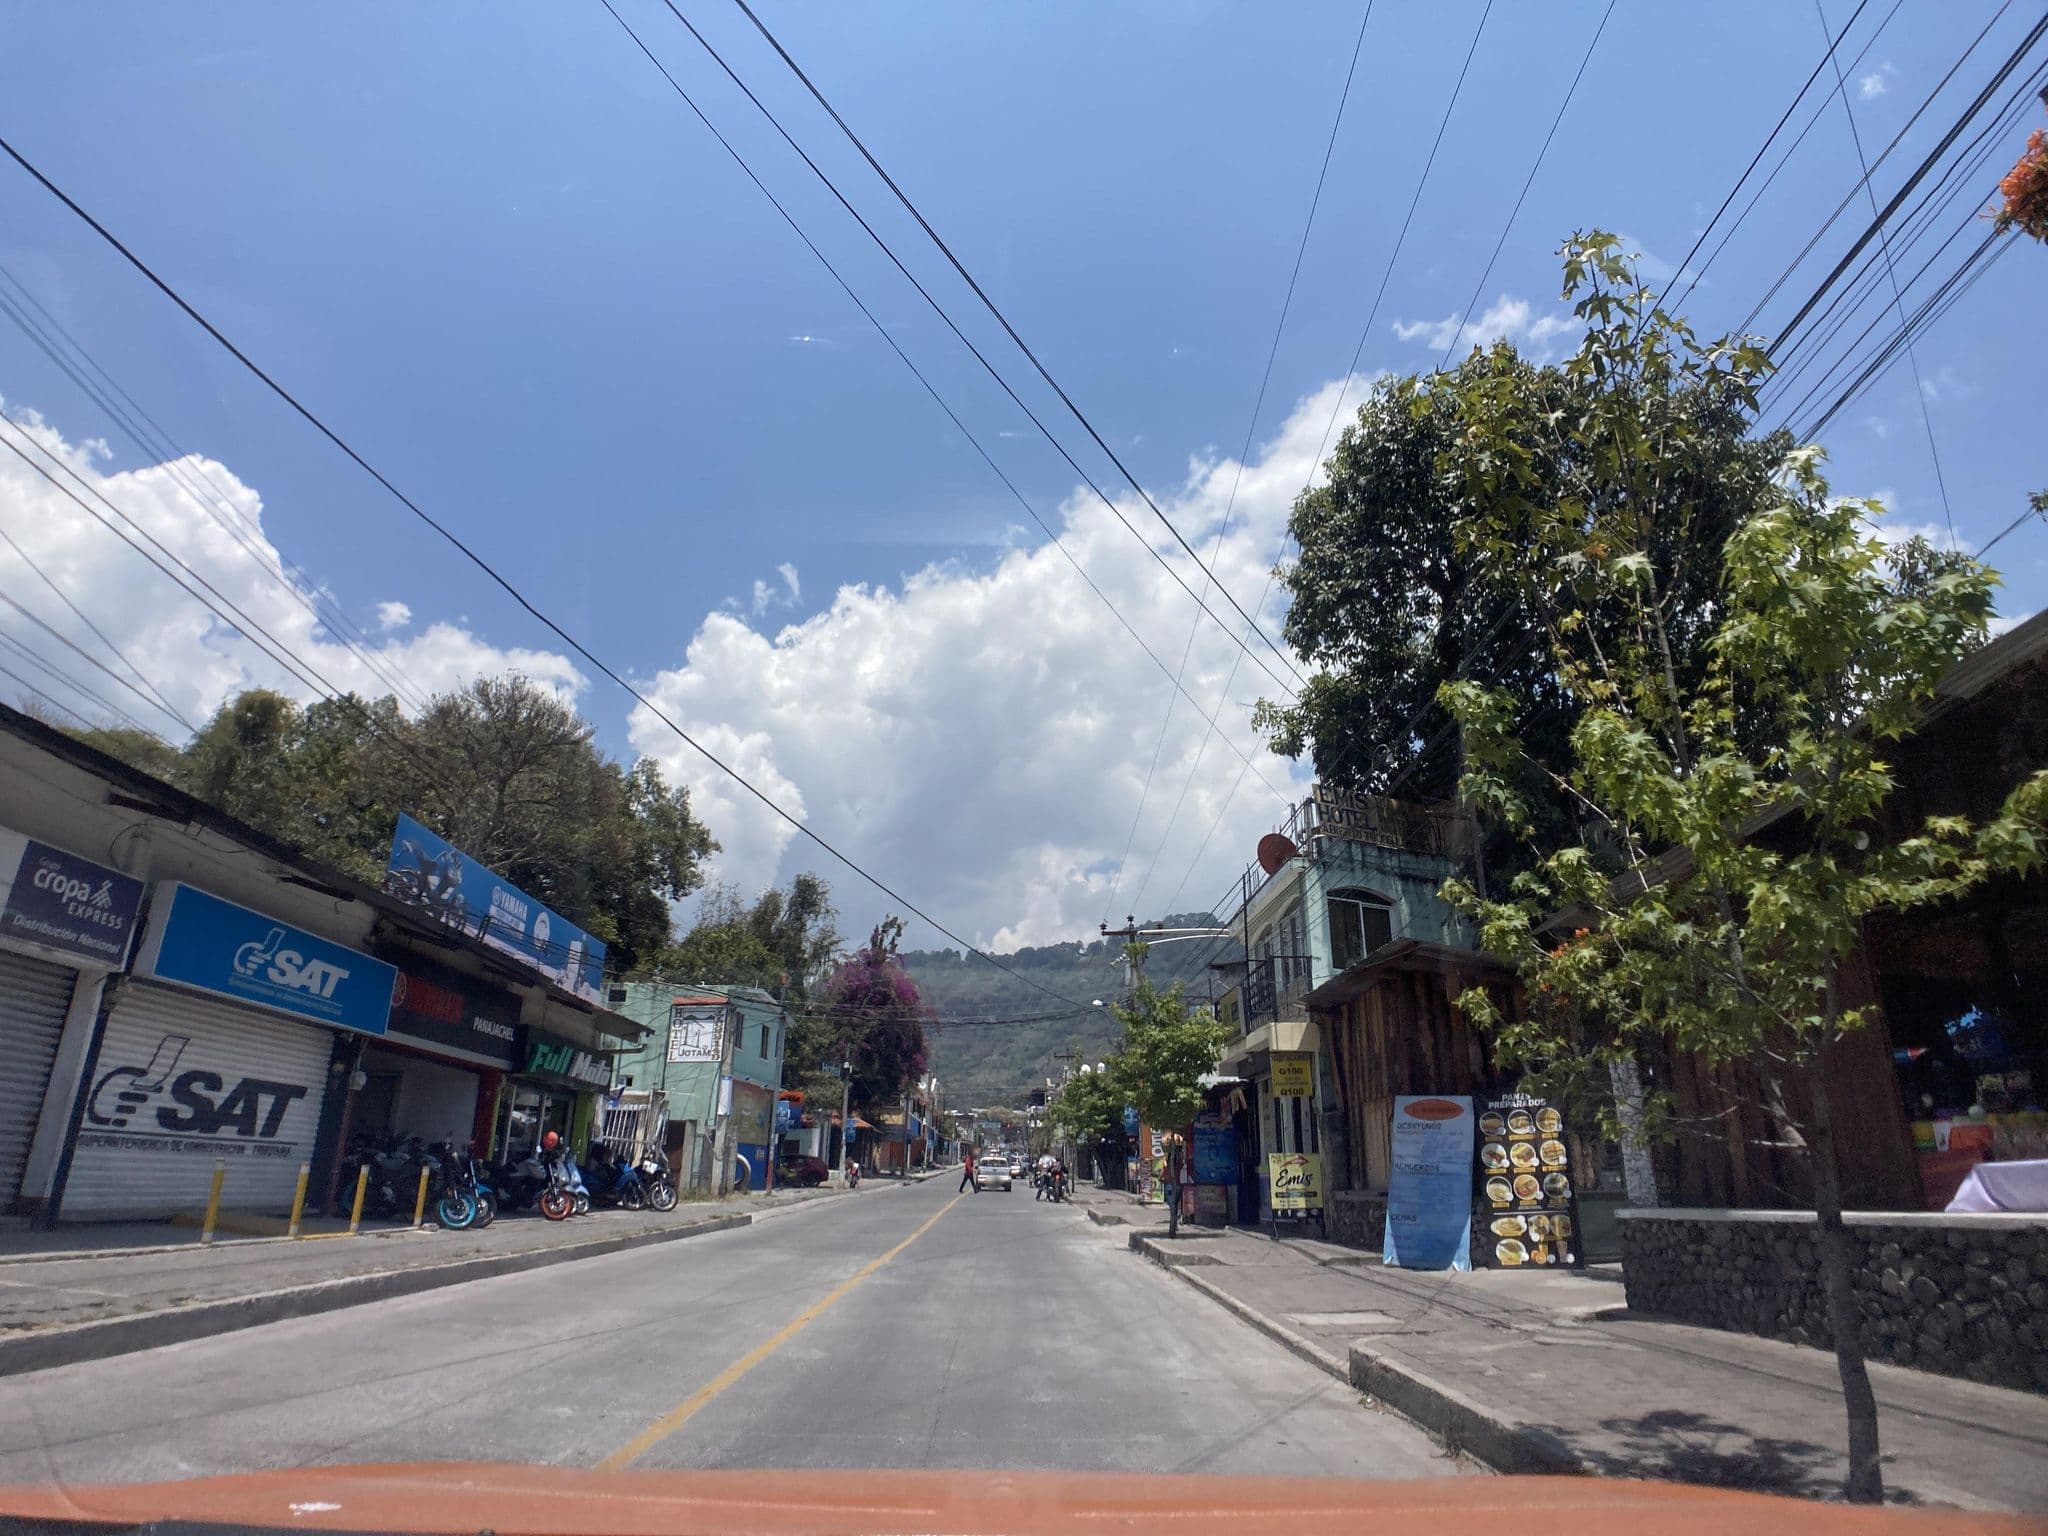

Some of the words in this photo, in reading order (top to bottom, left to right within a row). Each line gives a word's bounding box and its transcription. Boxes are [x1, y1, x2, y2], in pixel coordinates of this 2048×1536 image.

[33, 868, 91, 903] cropa
[67, 902, 123, 930] EXPRESS
[500, 890, 528, 922] YAMAHA
[267, 949, 351, 998] SAT
[473, 1016, 514, 1041] PANAJACHEL
[669, 1007, 683, 1061] HOTEL
[156, 1070, 308, 1137] SAT
[1488, 1098, 1547, 1109] PREPARADOS
